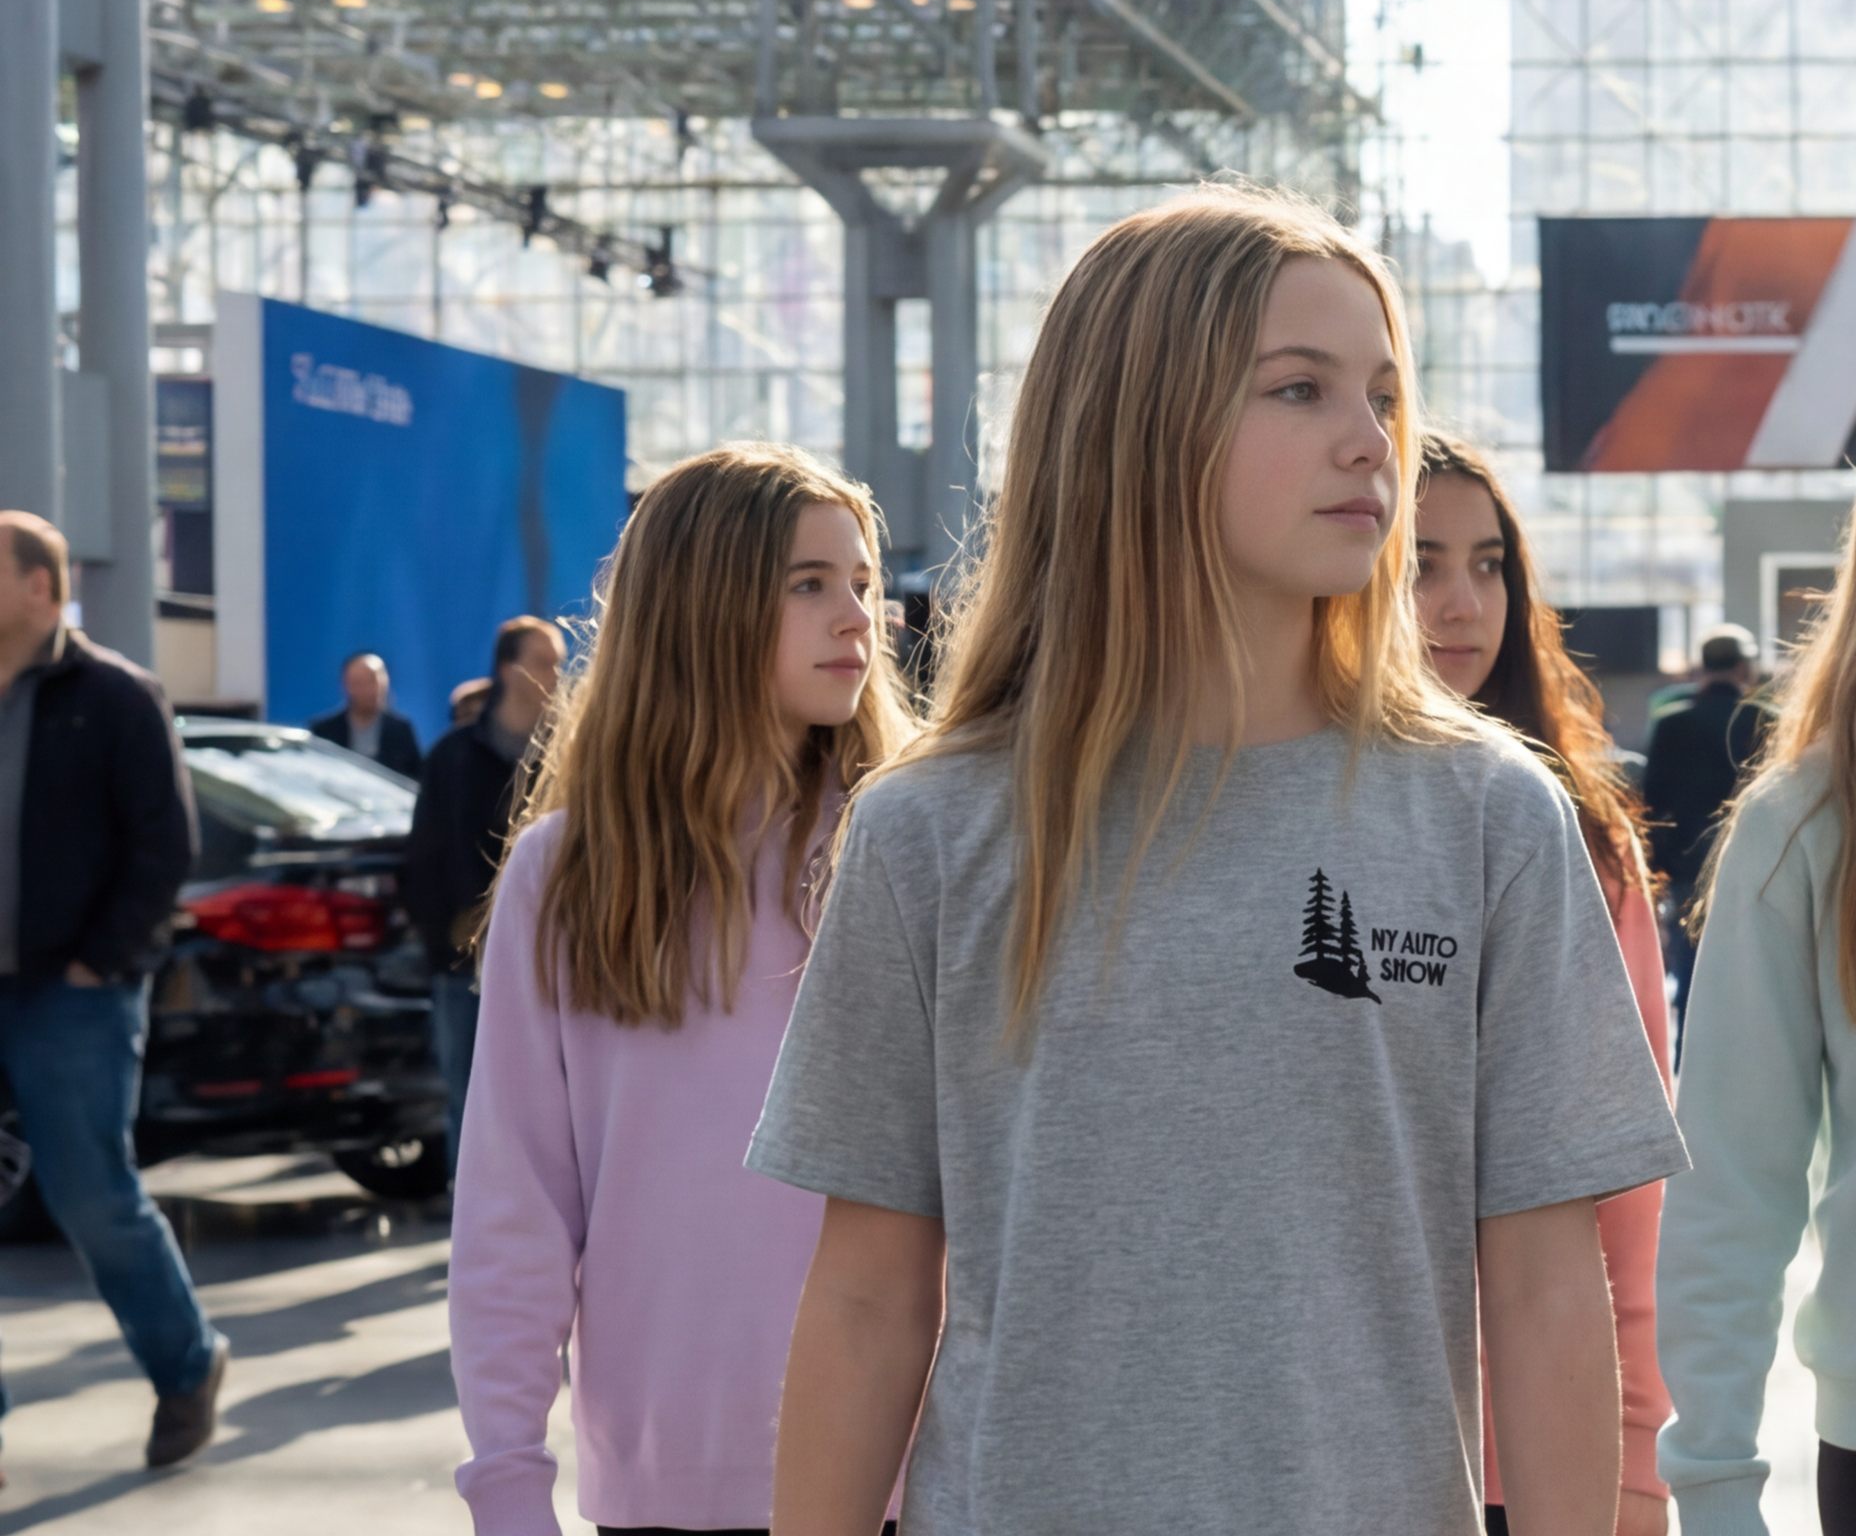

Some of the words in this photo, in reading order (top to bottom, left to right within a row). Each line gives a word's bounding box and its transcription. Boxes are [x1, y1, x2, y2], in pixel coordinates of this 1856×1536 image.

[1371, 927, 1399, 952] NY
[1400, 930, 1458, 959] AUTO
[1380, 957, 1447, 987] SHOW
